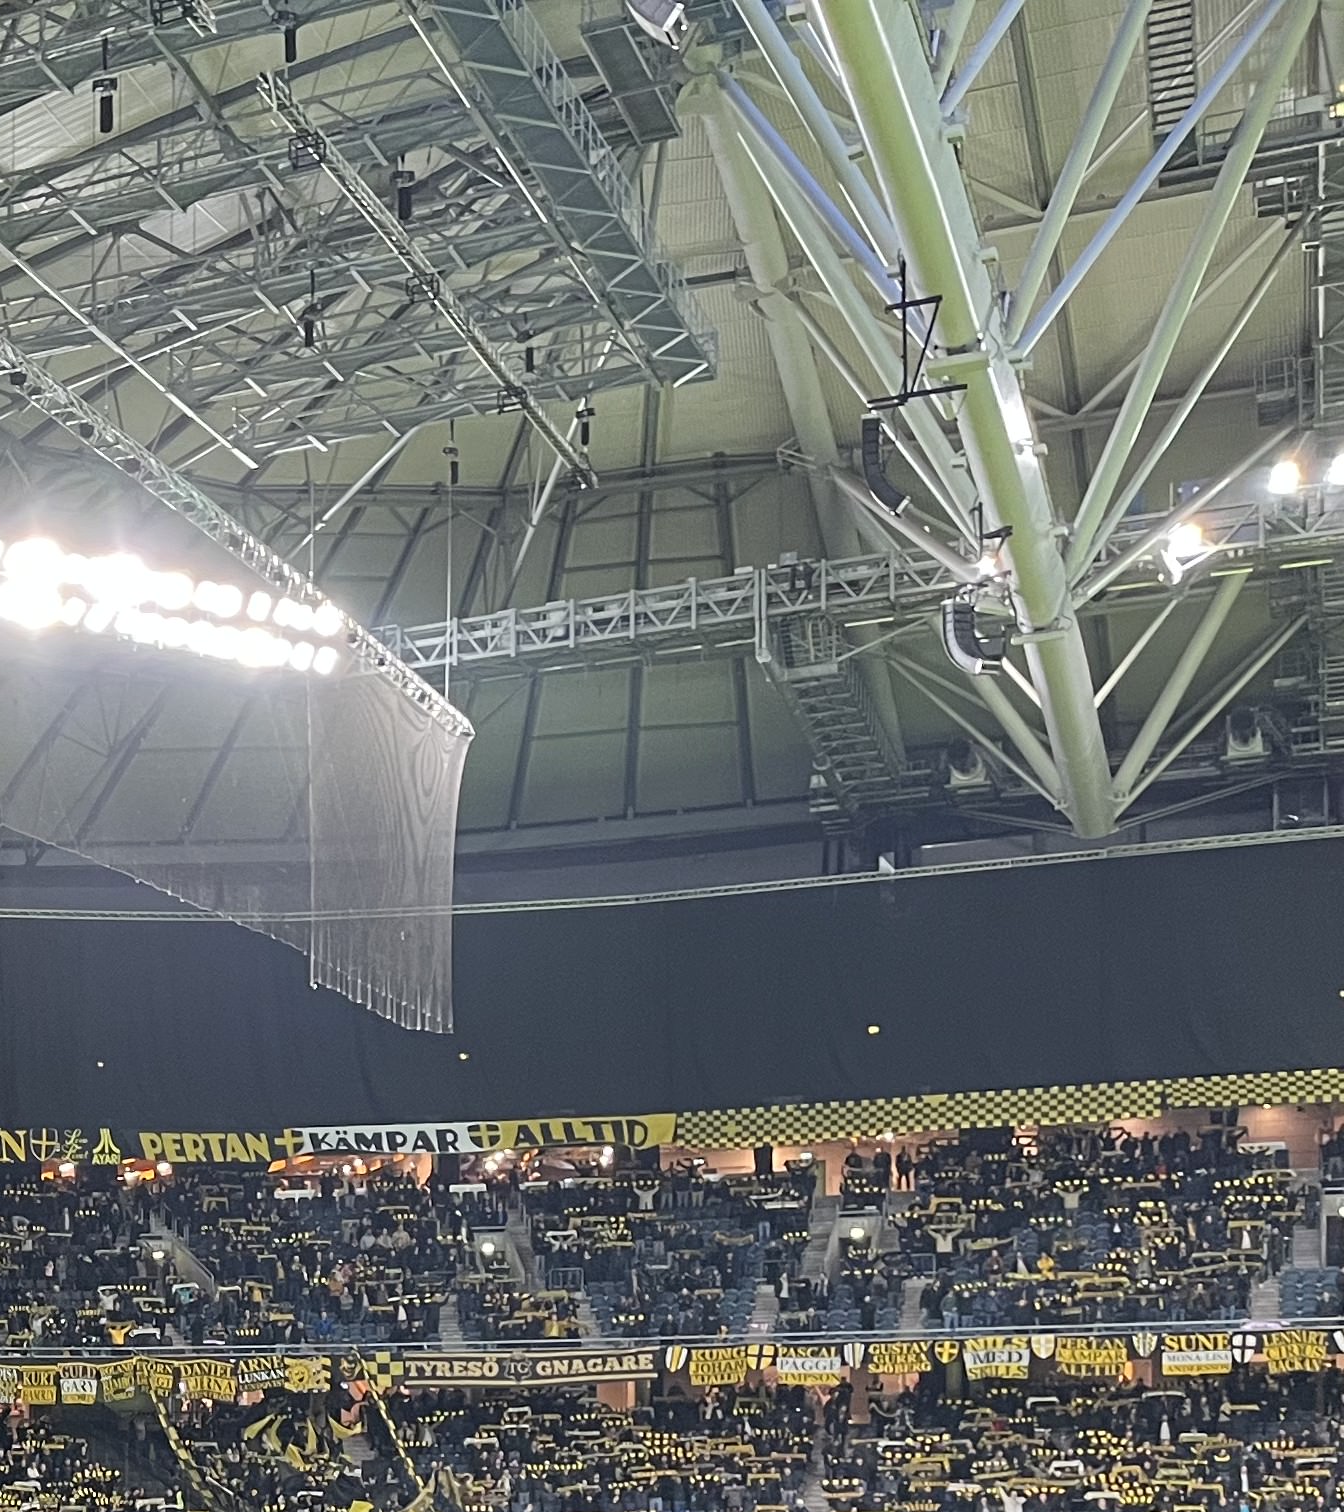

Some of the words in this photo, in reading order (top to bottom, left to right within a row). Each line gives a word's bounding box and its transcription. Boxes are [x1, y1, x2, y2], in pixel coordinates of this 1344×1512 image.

[312, 1129, 459, 1153] KÄMPAR
[514, 1119, 648, 1148] ALLTID
[139, 1131, 271, 1163] PERTAN
[868, 1341, 934, 1355] GUSTAV
[964, 1336, 1030, 1352] NILS
[1056, 1337, 1126, 1350] PERTAN
[1163, 1334, 1232, 1351] SUNE
[691, 1346, 746, 1361] KUNG
[778, 1346, 838, 1359] PASCAL
[972, 1350, 1023, 1365] MED
[238, 1356, 283, 1373] ARNE
[405, 1356, 499, 1378] TYRESÖ
[536, 1353, 654, 1377] GNAGARE
[693, 1360, 744, 1374] JOHAN
[22, 1370, 56, 1386] KURT
